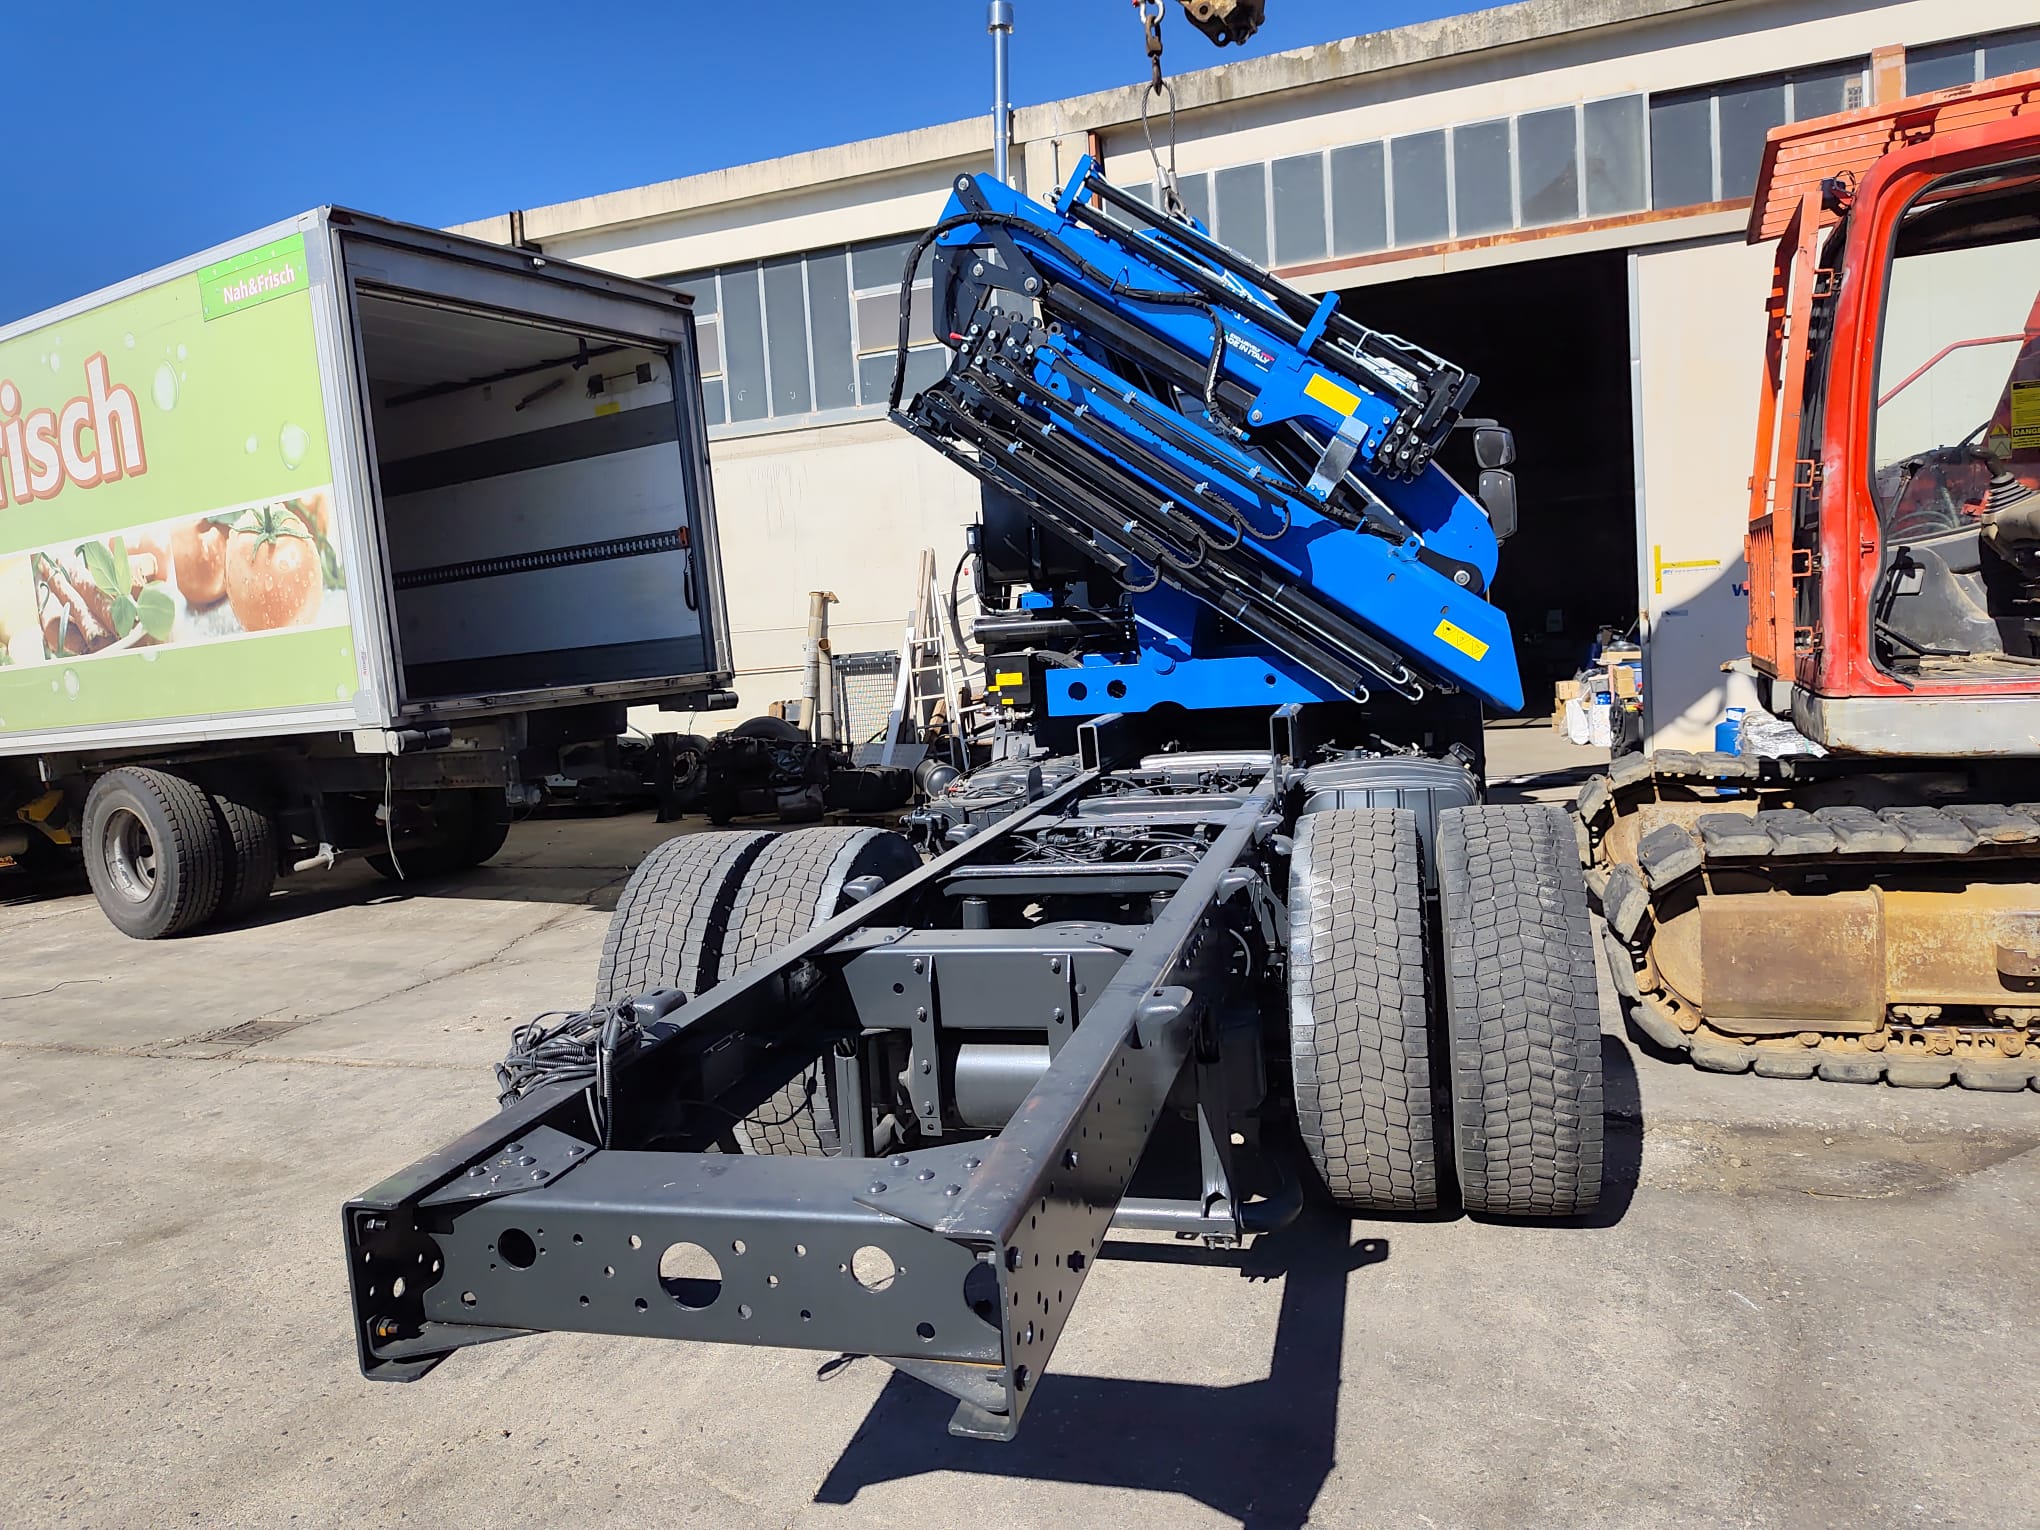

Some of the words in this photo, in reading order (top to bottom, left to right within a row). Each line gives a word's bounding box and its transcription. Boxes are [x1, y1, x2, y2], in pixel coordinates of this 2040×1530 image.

[223, 263, 296, 305] Nah&Frisch
[1238, 343, 1249, 353] IN
[1247, 349, 1270, 364] ITALY
